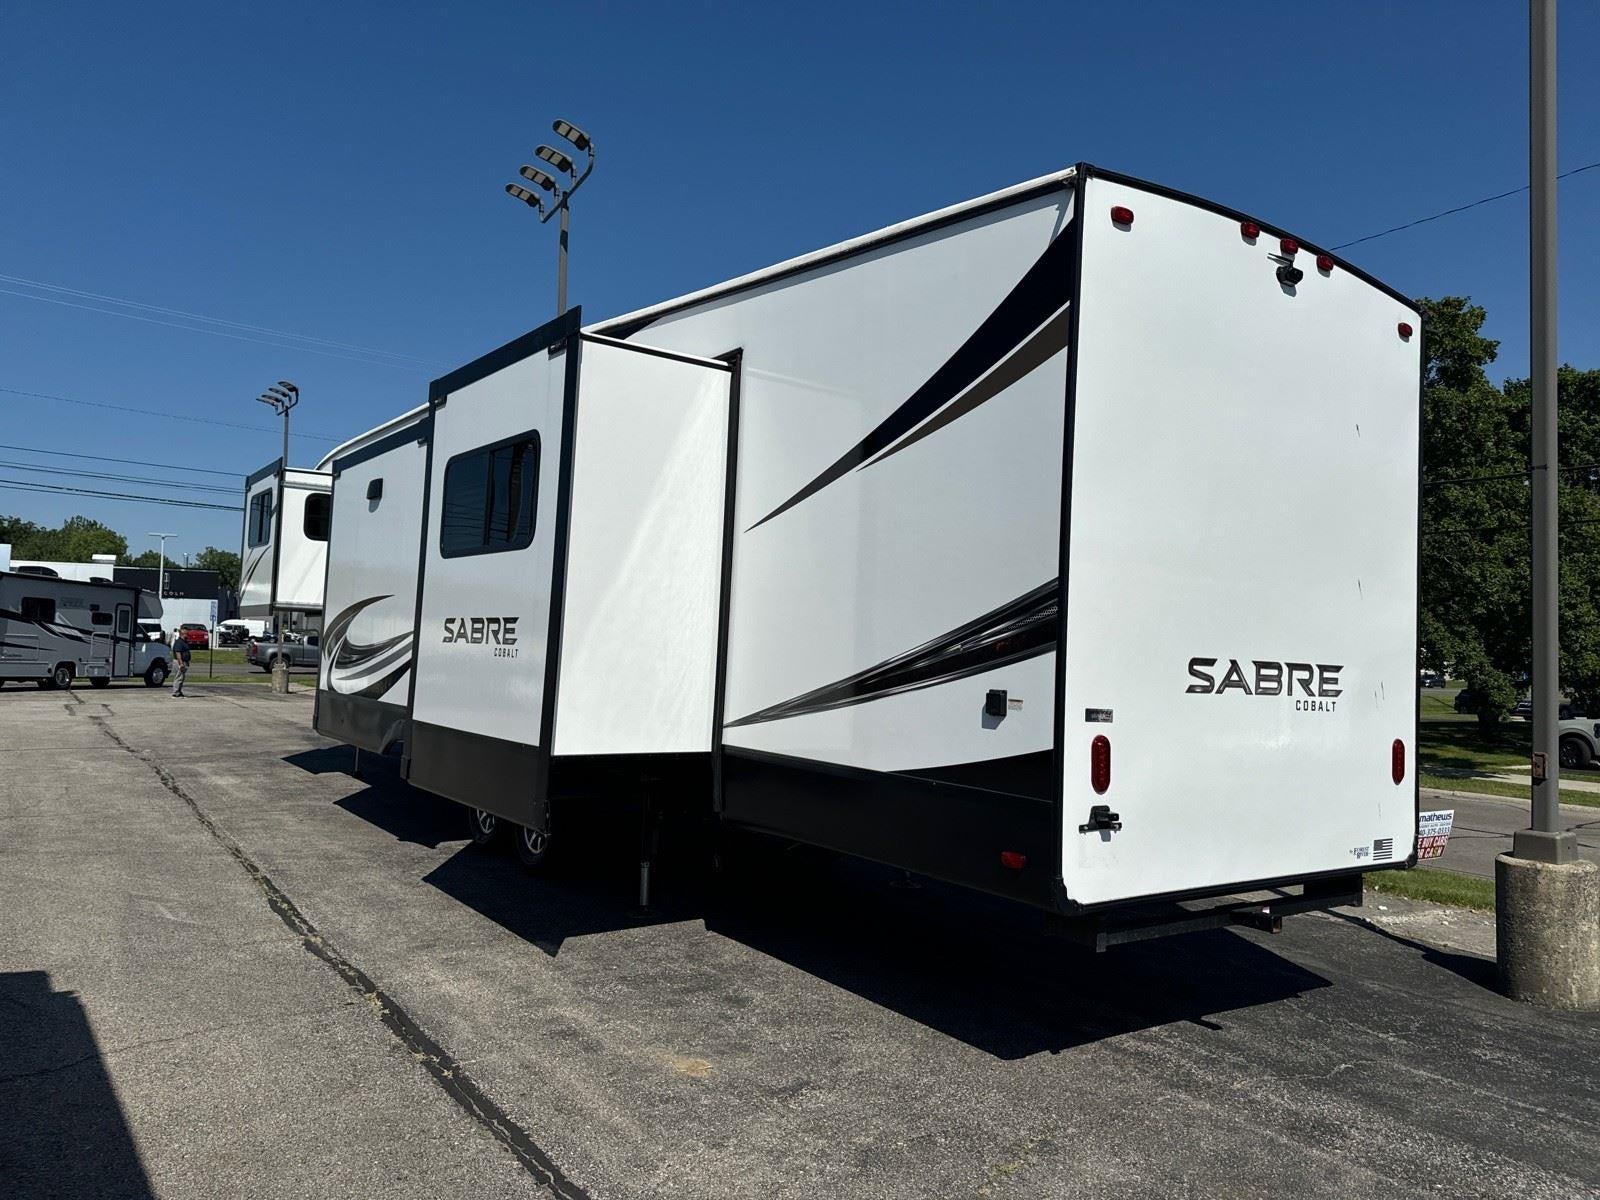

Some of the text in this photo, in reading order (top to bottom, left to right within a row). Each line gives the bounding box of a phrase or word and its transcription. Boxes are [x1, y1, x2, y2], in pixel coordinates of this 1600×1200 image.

[442, 617, 520, 645] SABRE
[494, 648, 519, 659] COBALT
[1185, 656, 1345, 698] SABRE
[1296, 700, 1338, 712] COBALT
[1419, 812, 1452, 822] mathews
